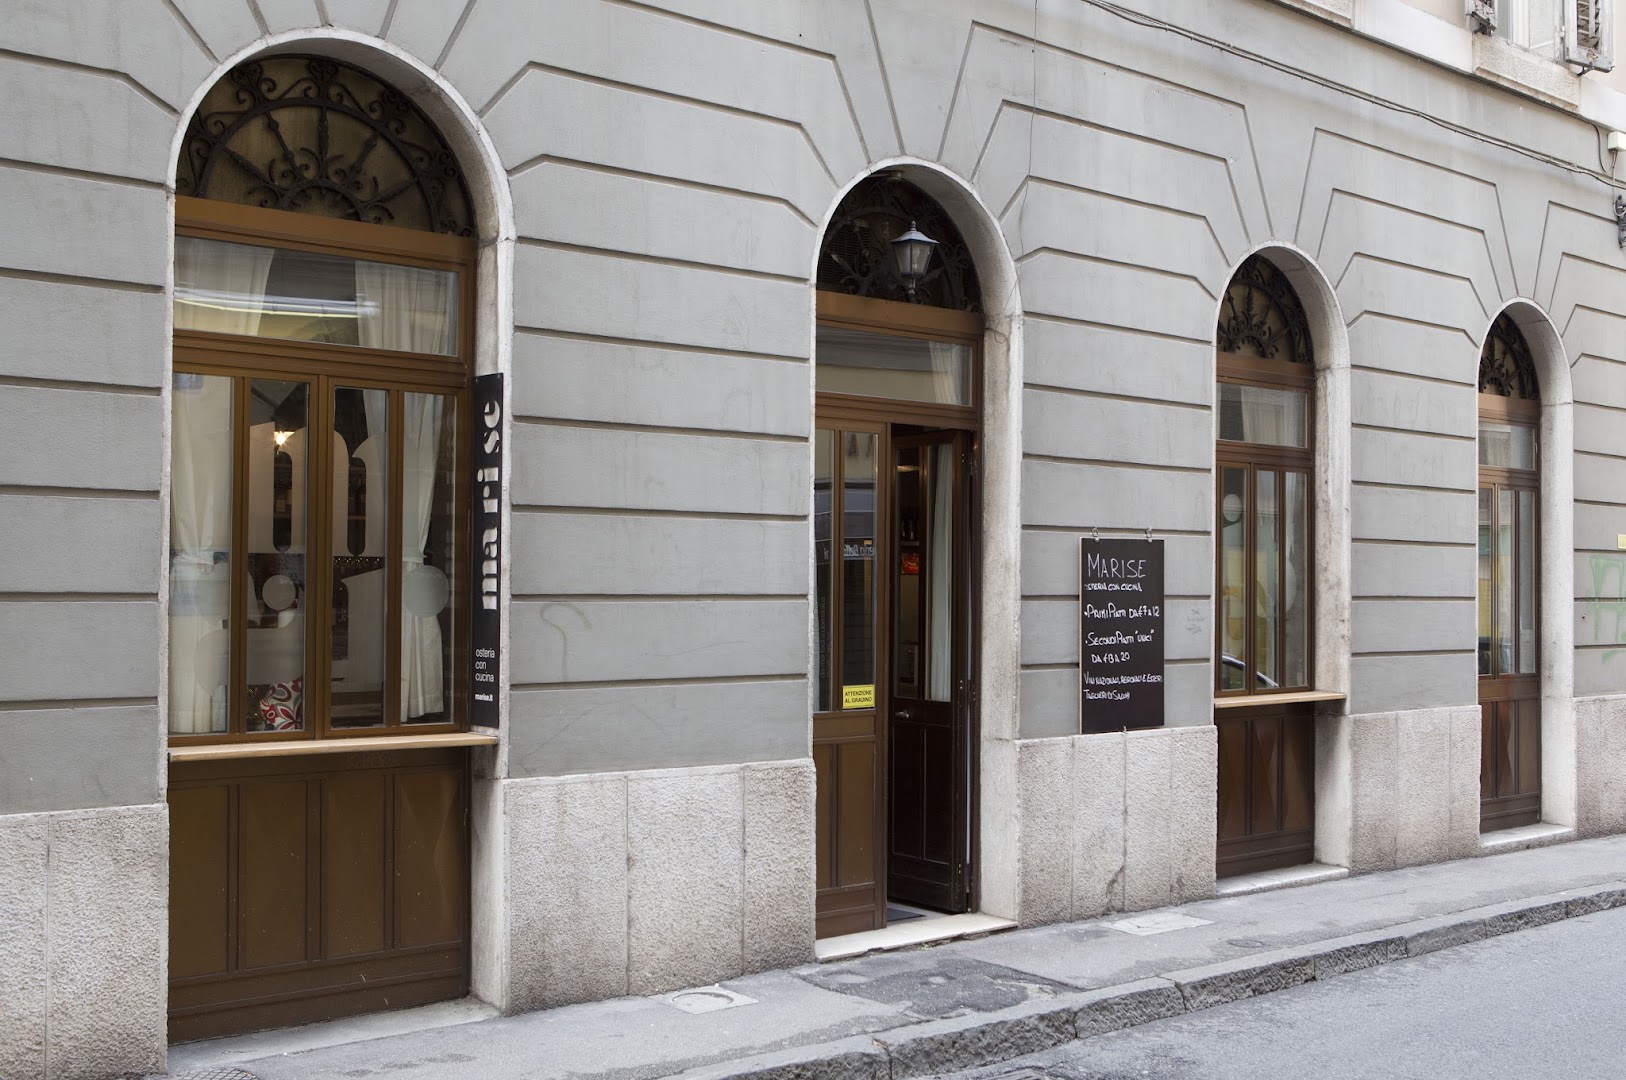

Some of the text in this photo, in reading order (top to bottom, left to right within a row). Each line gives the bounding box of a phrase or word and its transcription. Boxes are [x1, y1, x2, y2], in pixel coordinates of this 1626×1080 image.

[1087, 552, 1147, 578] MARISE
[1107, 583, 1120, 591] CON
[475, 647, 495, 658] osteria
[1091, 653, 1102, 664] DA
[1120, 651, 1131, 662] 20
[475, 661, 487, 670] con
[475, 672, 495, 682] cucina
